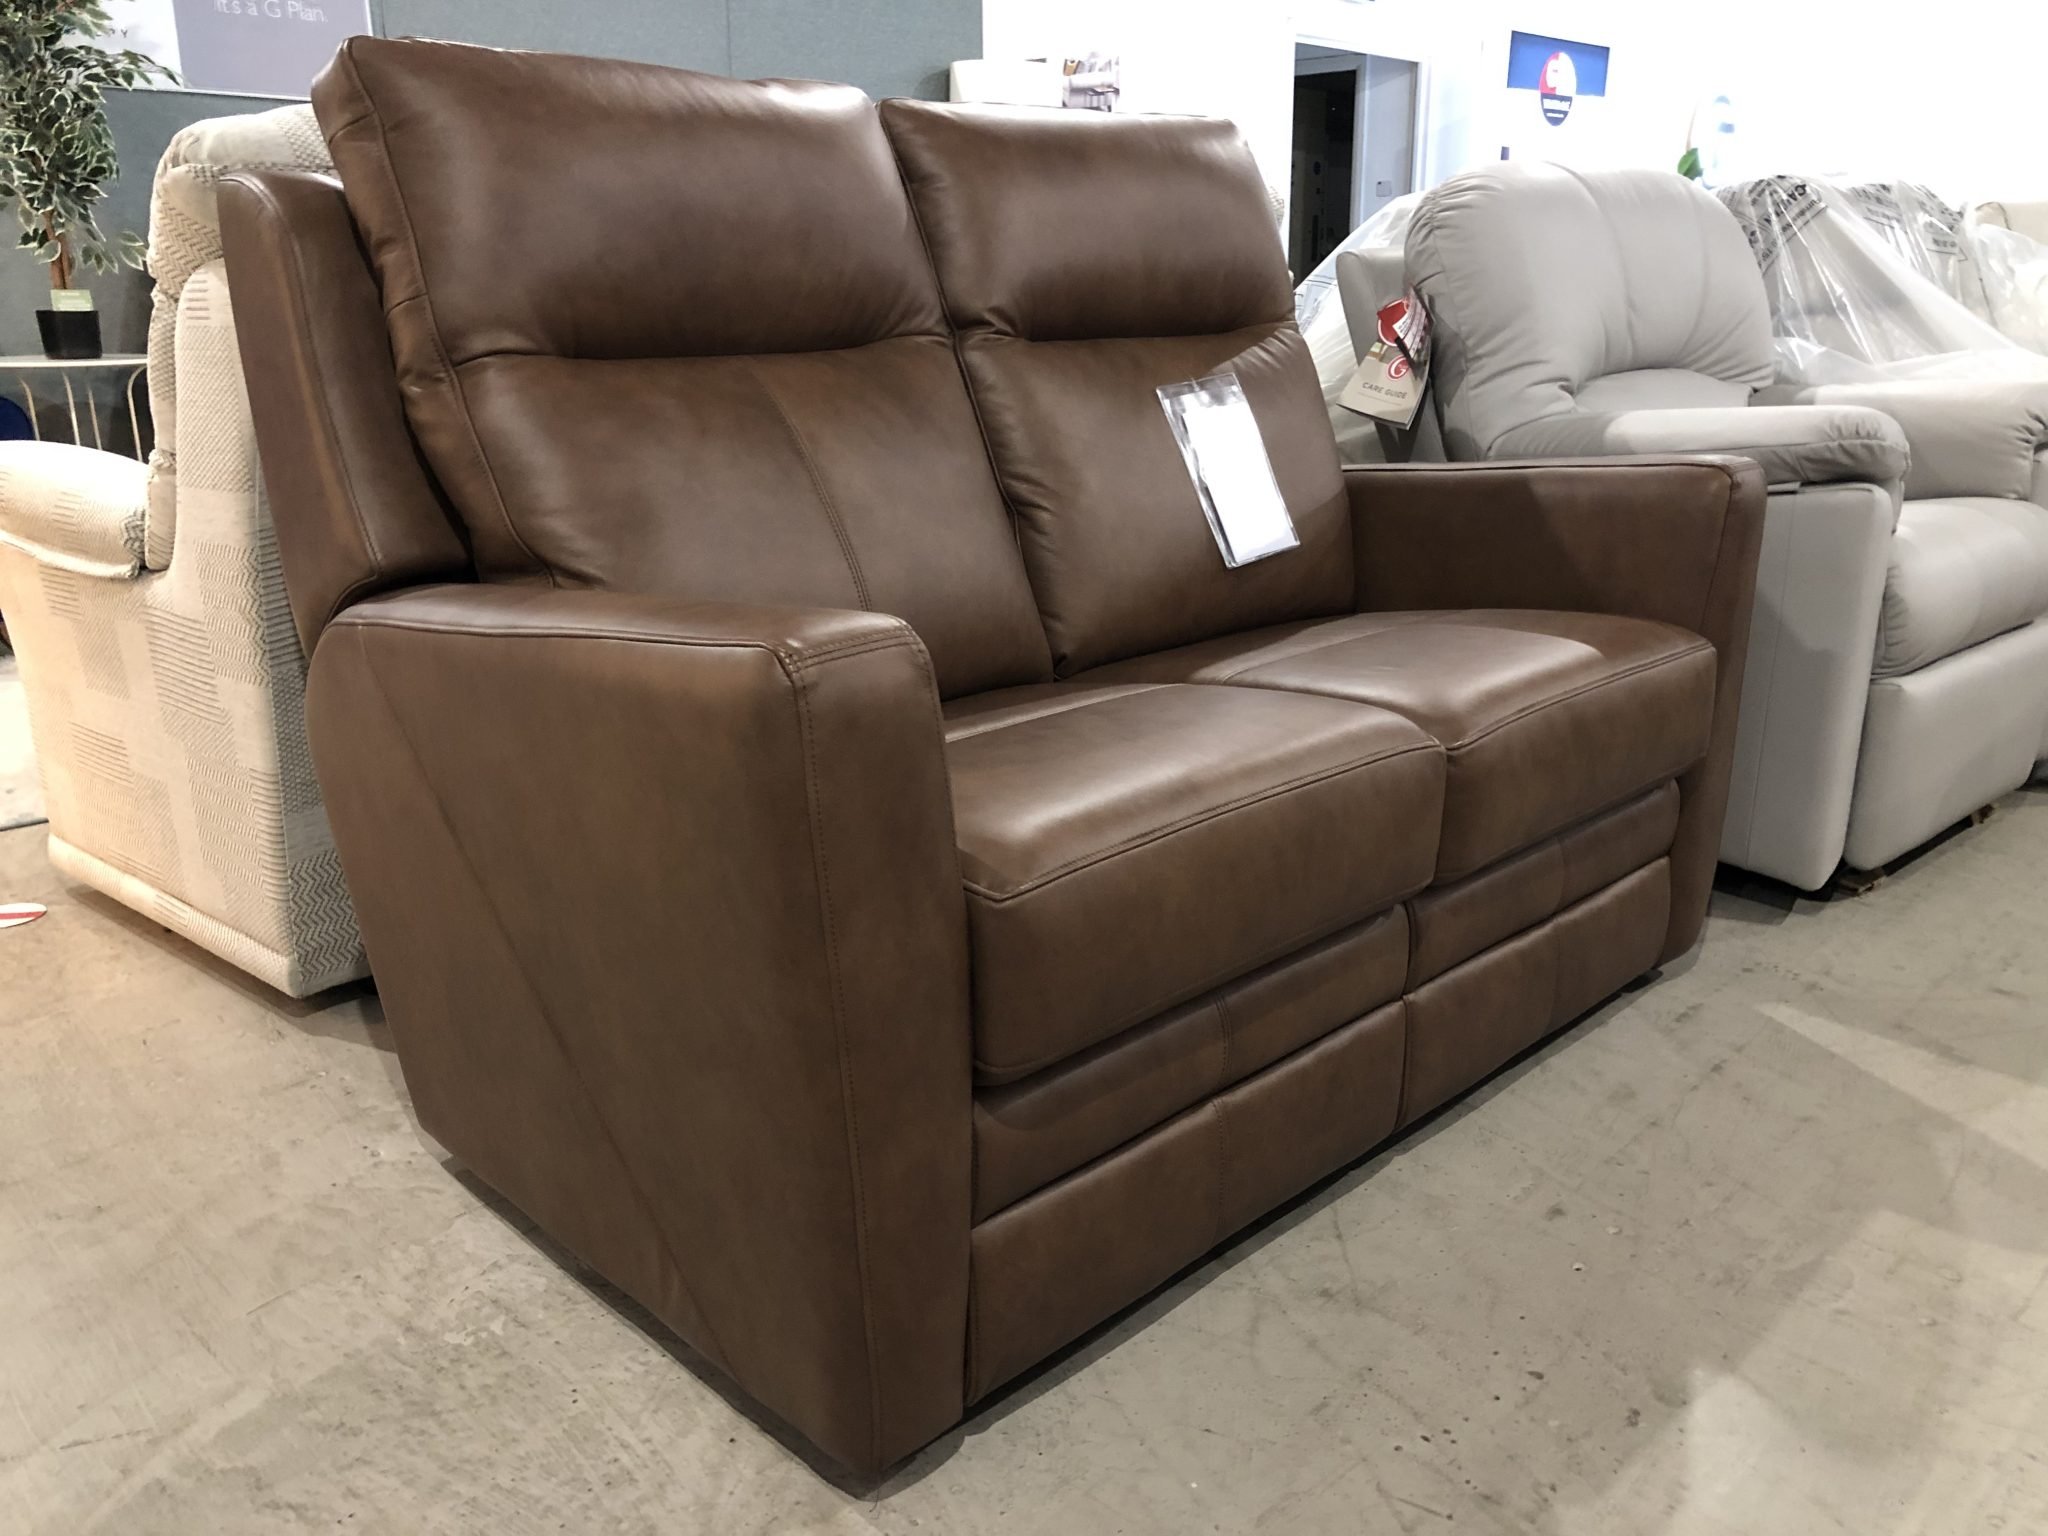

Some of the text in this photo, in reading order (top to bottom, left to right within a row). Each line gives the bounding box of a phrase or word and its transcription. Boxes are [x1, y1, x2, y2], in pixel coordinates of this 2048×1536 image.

[215, 0, 329, 22] Its a G Plan.
[1362, 382, 1407, 399] CARE GUIDE
